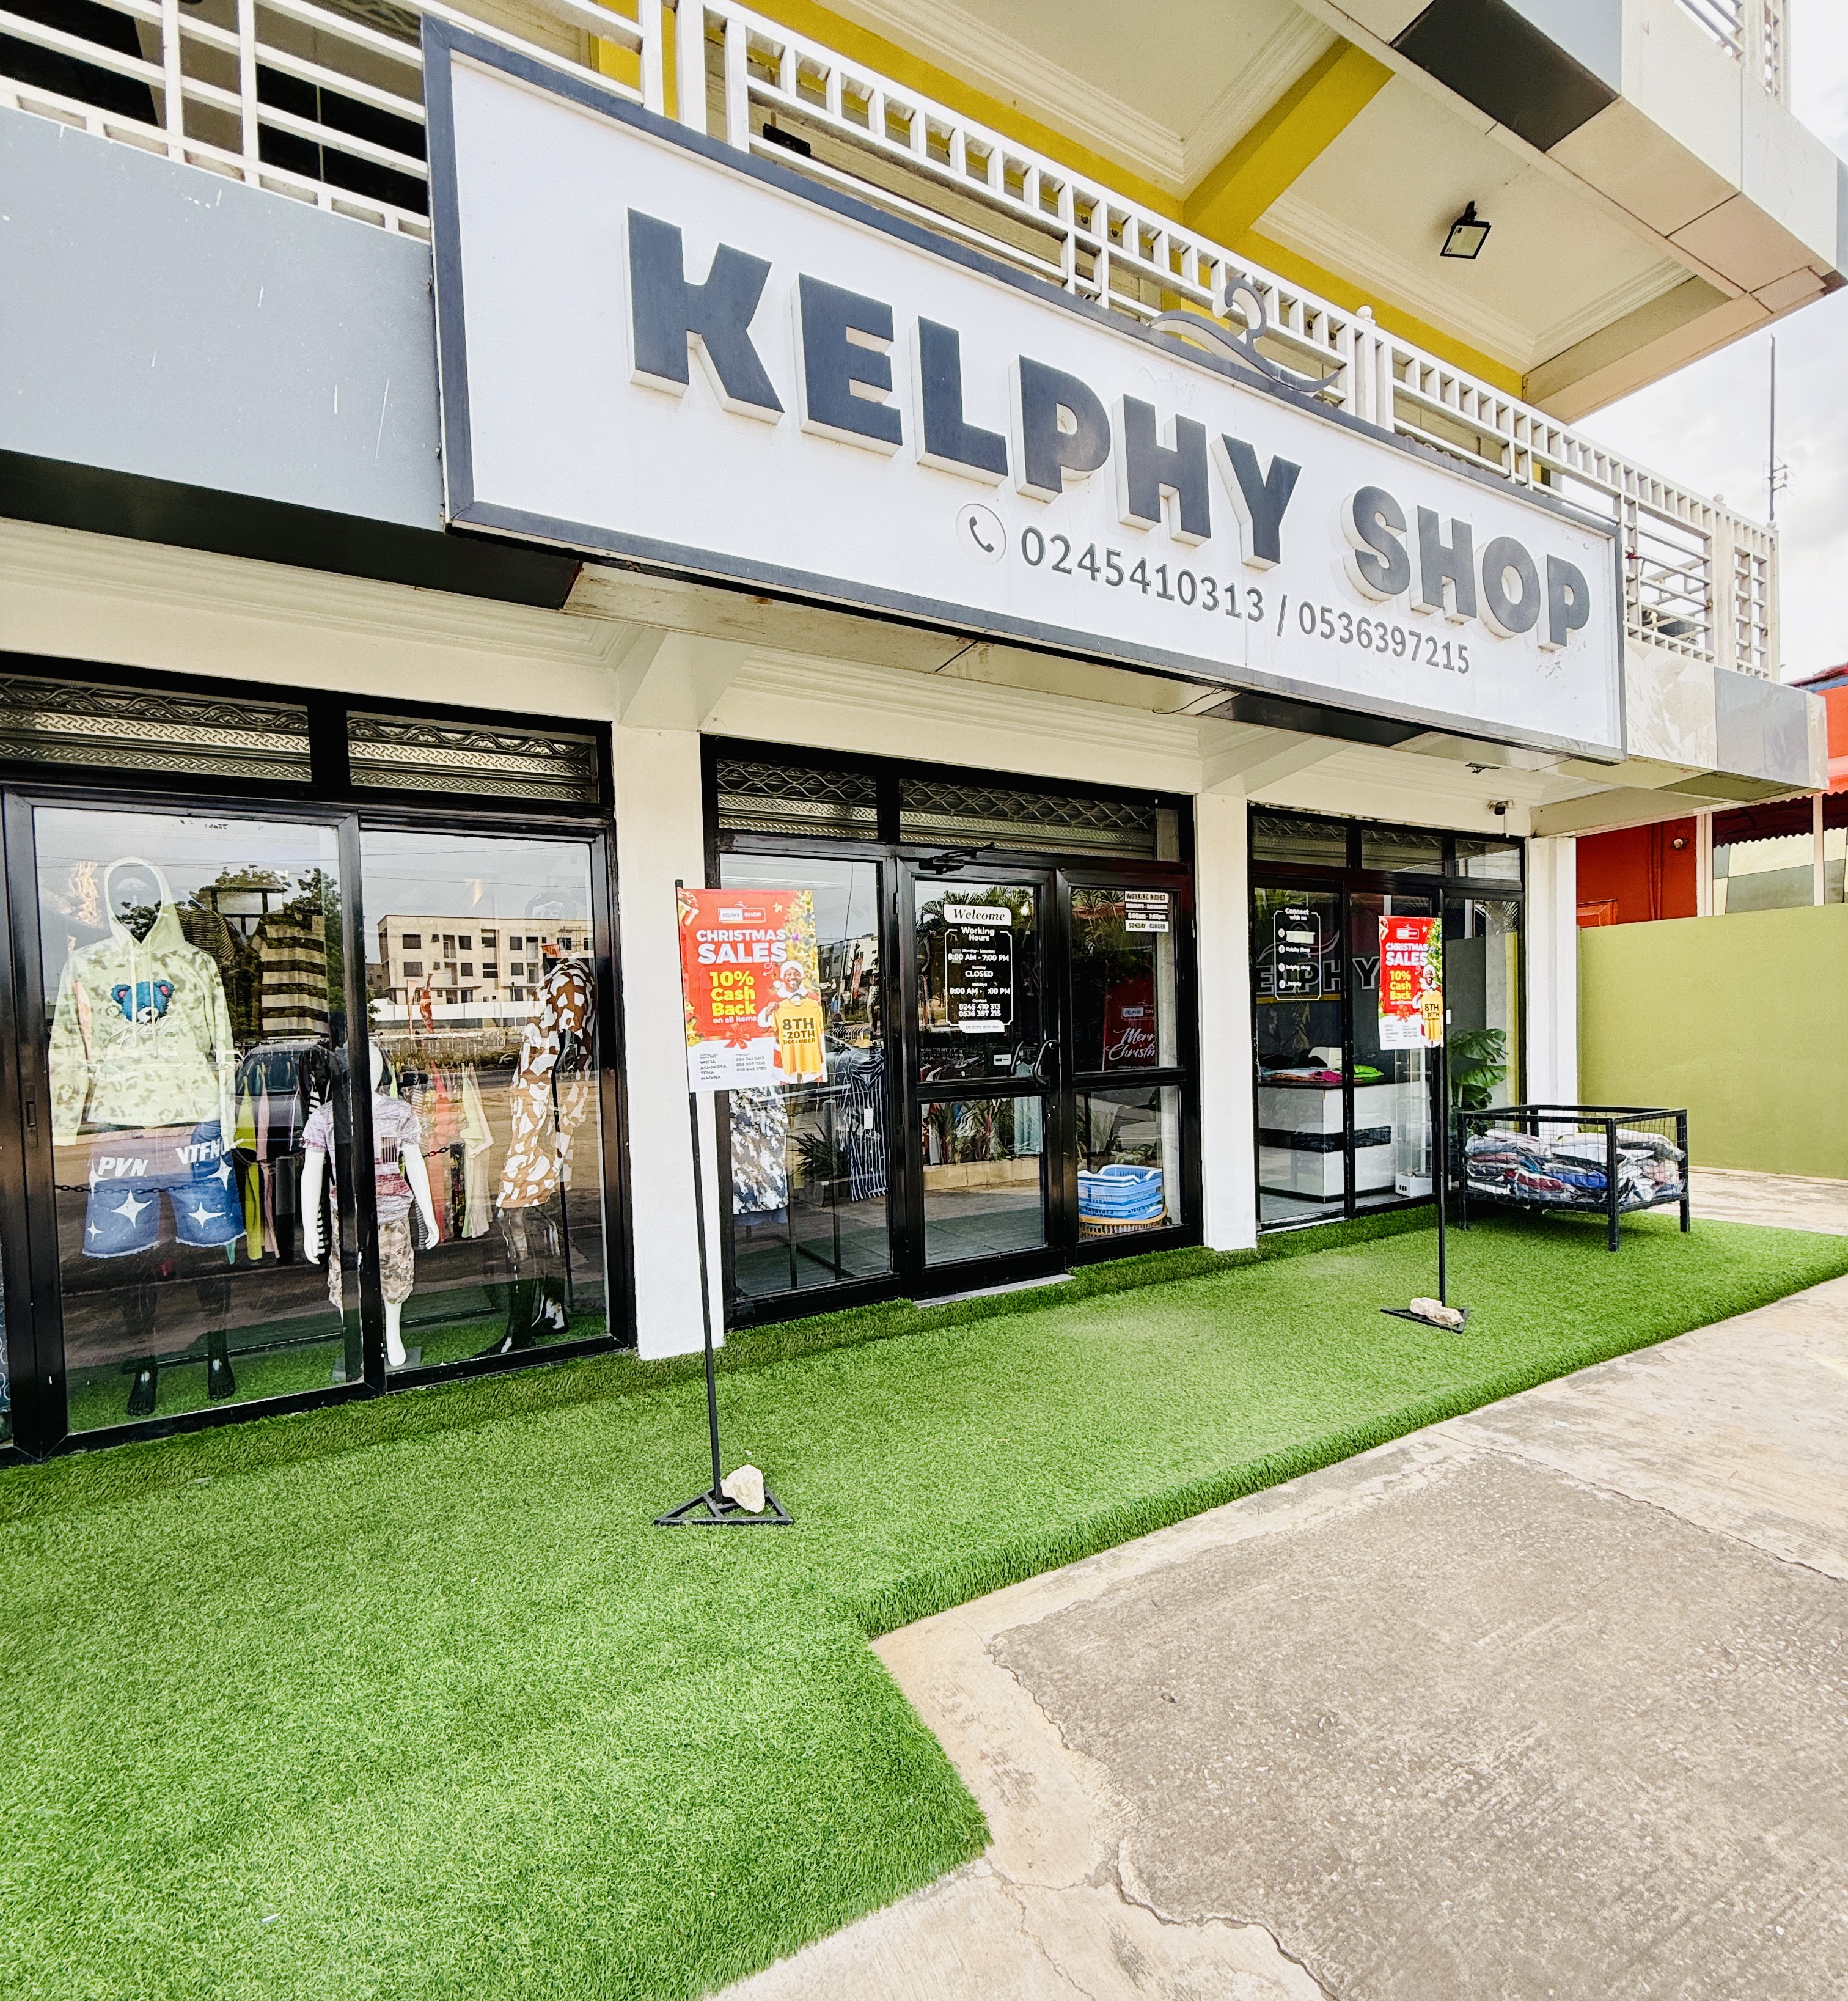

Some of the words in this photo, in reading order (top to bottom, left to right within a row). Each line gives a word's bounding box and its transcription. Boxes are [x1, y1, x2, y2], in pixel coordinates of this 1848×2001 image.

[625, 207, 1302, 571] KELPHY
[1341, 486, 1590, 652] SHOP
[1021, 526, 1264, 622] 0245410313
[1277, 594, 1287, 637] /
[1298, 600, 1470, 674] 0536397215
[953, 909, 1005, 921] Welcome
[696, 929, 787, 942] CHRISTMAS
[961, 927, 996, 937] Working
[697, 942, 787, 964] SALES
[1385, 942, 1428, 951] CHRISTMAS
[1385, 951, 1428, 966] SALES
[710, 971, 755, 987] 10%
[1390, 970, 1412, 981] 10%
[1390, 980, 1412, 991] Cash
[711, 986, 755, 1002] Cash
[1390, 991, 1412, 1000] Back
[711, 1000, 757, 1016] Back
[782, 1018, 814, 1030] 8TH
[783, 1030, 815, 1039] -20TH
[98, 1156, 148, 1177] PVN
